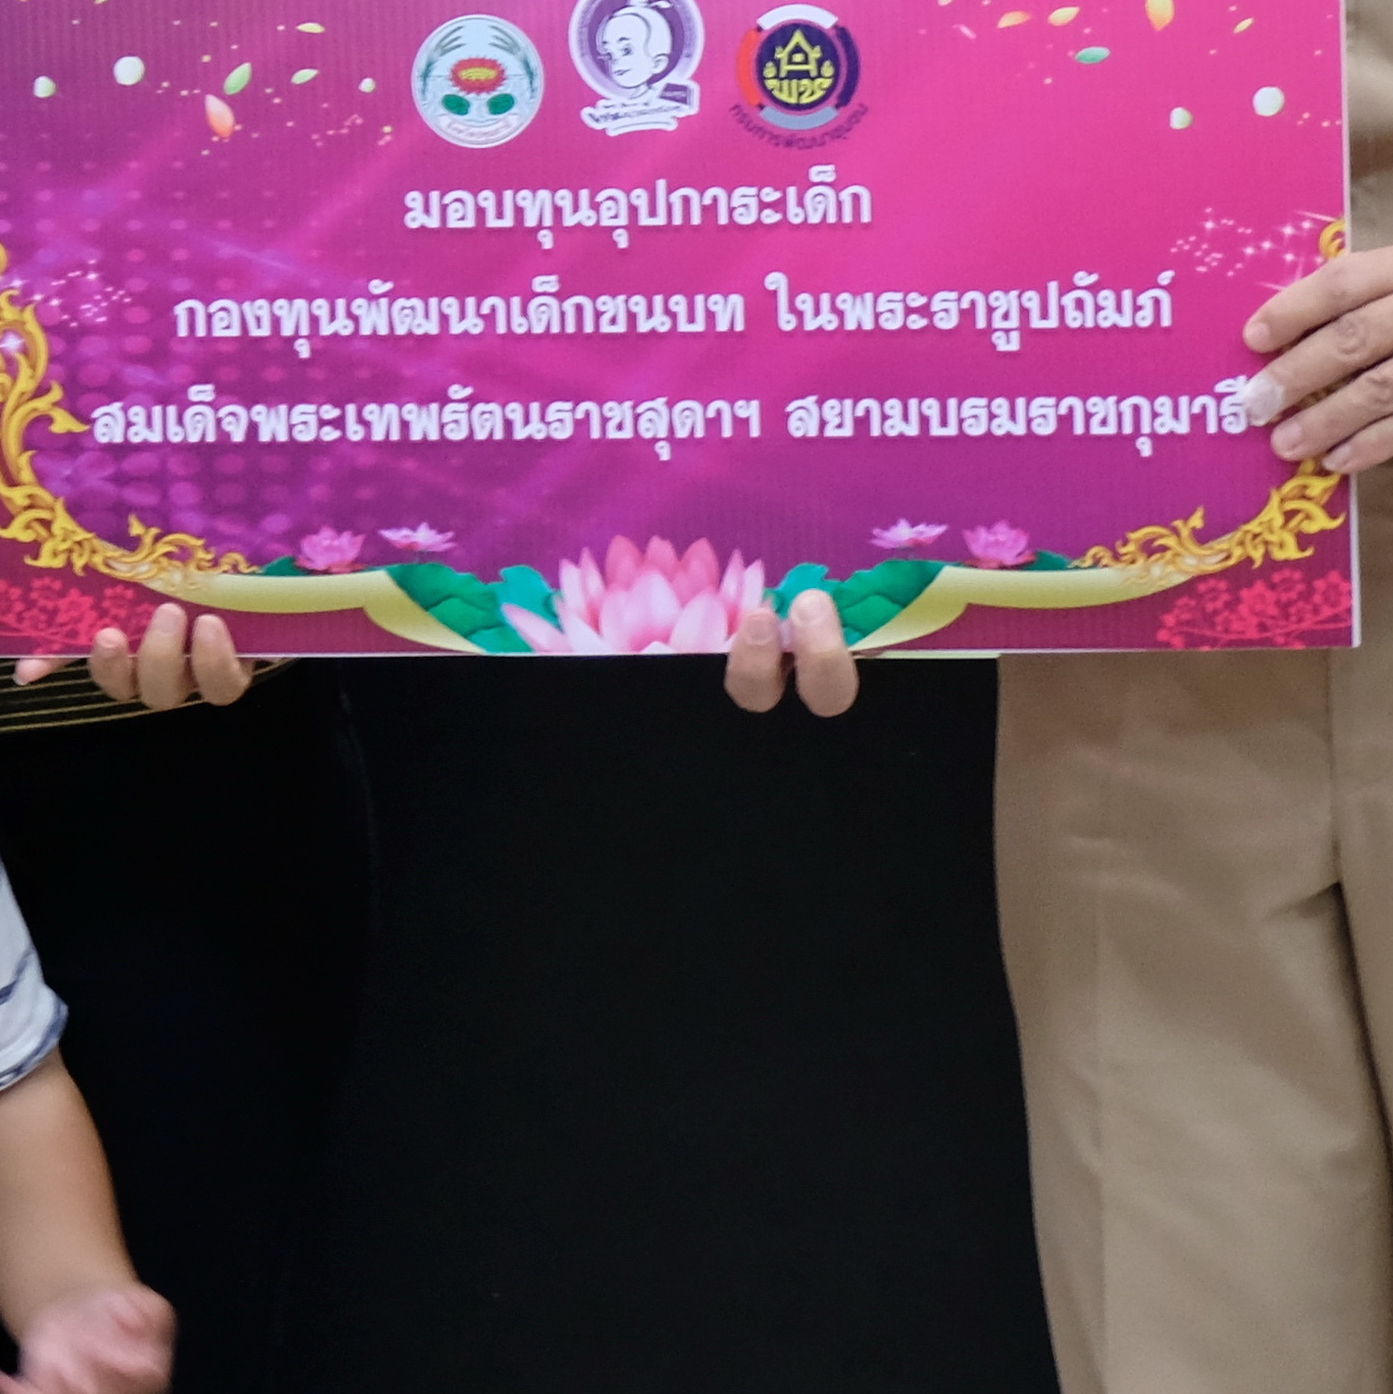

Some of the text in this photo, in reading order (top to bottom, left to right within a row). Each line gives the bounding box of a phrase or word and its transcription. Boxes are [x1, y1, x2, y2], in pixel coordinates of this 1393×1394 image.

[403, 164, 873, 250] มอบทุนอุปการะเด็ก
[173, 269, 1176, 359] กองทุนพัฒนาเด็กชนบท ในพระราชูปถัมภ์
[92, 375, 1249, 461] สมเด็จพระเทพรัตนราชสุดาฯ สยามบรมราชกุมารี
